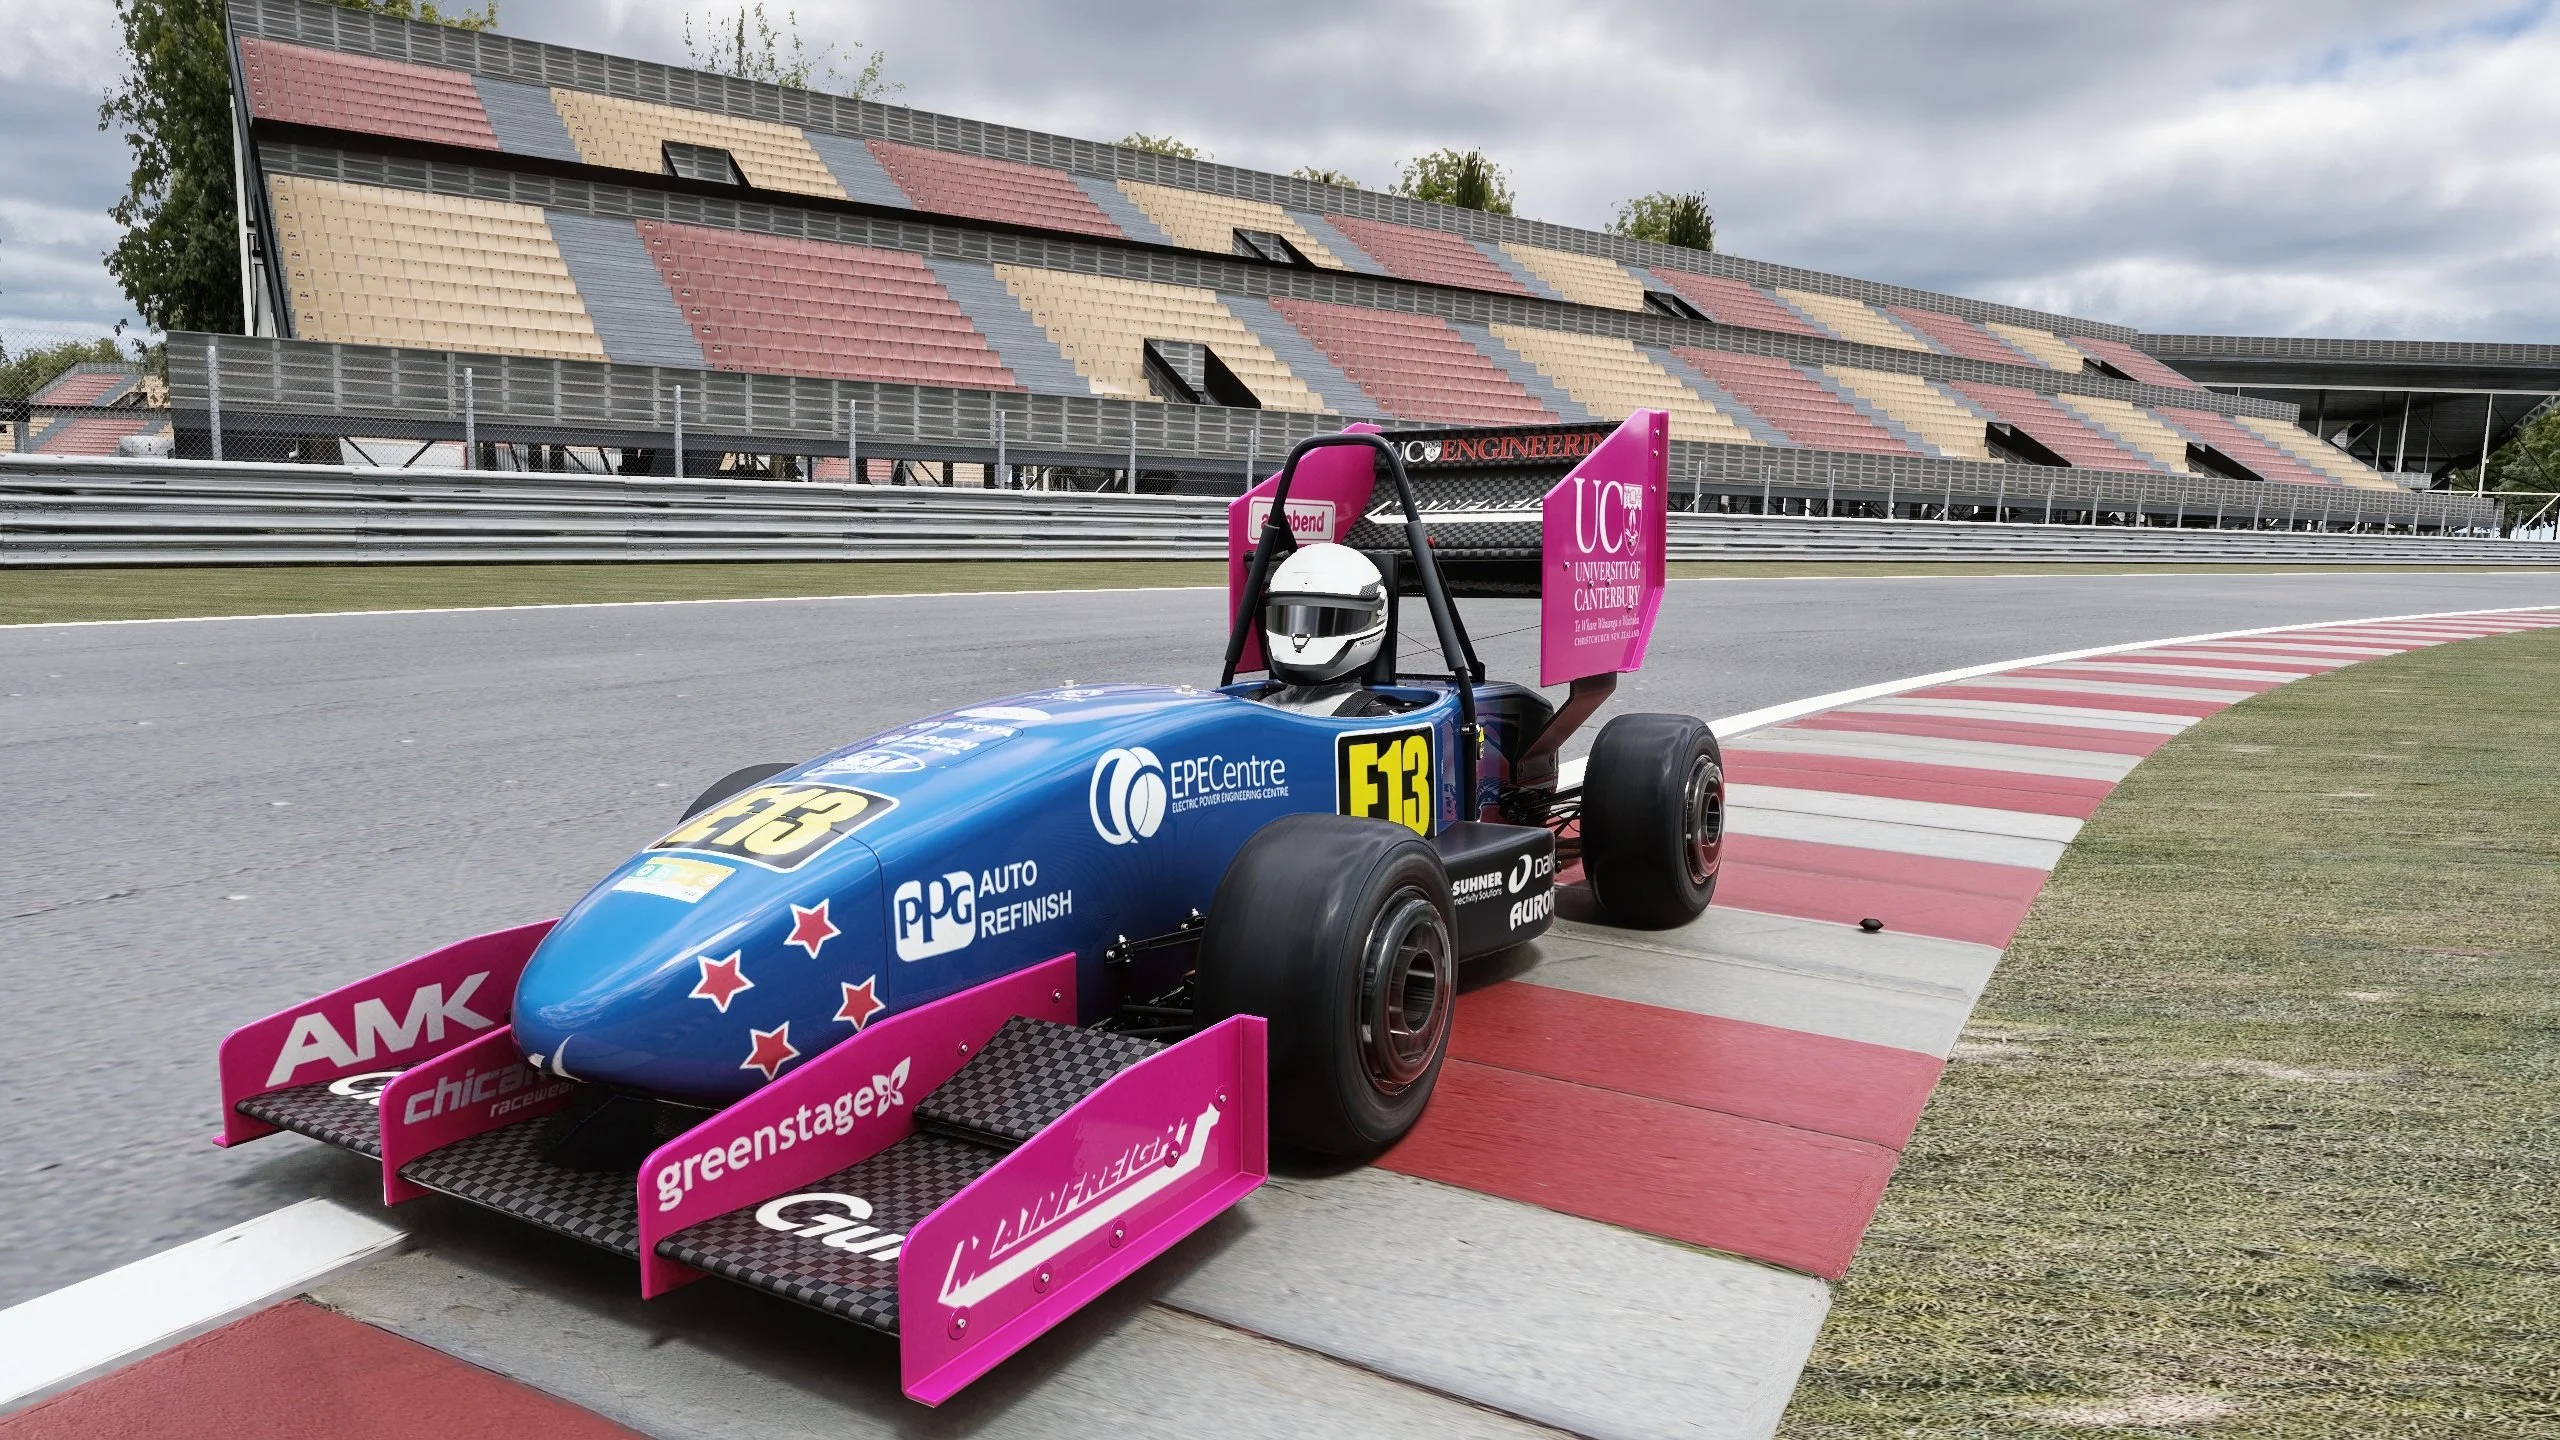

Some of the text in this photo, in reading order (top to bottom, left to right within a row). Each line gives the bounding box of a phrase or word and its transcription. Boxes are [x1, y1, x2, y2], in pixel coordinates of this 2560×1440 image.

[1573, 477, 1623, 554] UC
[1575, 560, 1641, 582] UNIVERSITY OF
[1574, 585, 1641, 612] CANTERBURY
[1574, 620, 1581, 633] Te
[1574, 629, 1640, 647] CHRISTCHURCH NEW ZEALAND
[1170, 754, 1286, 799] EPECentre
[1172, 786, 1289, 814] ELECTRIC POWER ENGINEERING CENTRE
[1451, 871, 1503, 897] SUHNER
[1453, 888, 1503, 907] nectivity Solutions
[897, 859, 1038, 944] PPG AUTO
[981, 889, 1073, 939] REFINISH
[265, 970, 495, 1089] AMK
[656, 1085, 875, 1213] greenstage
